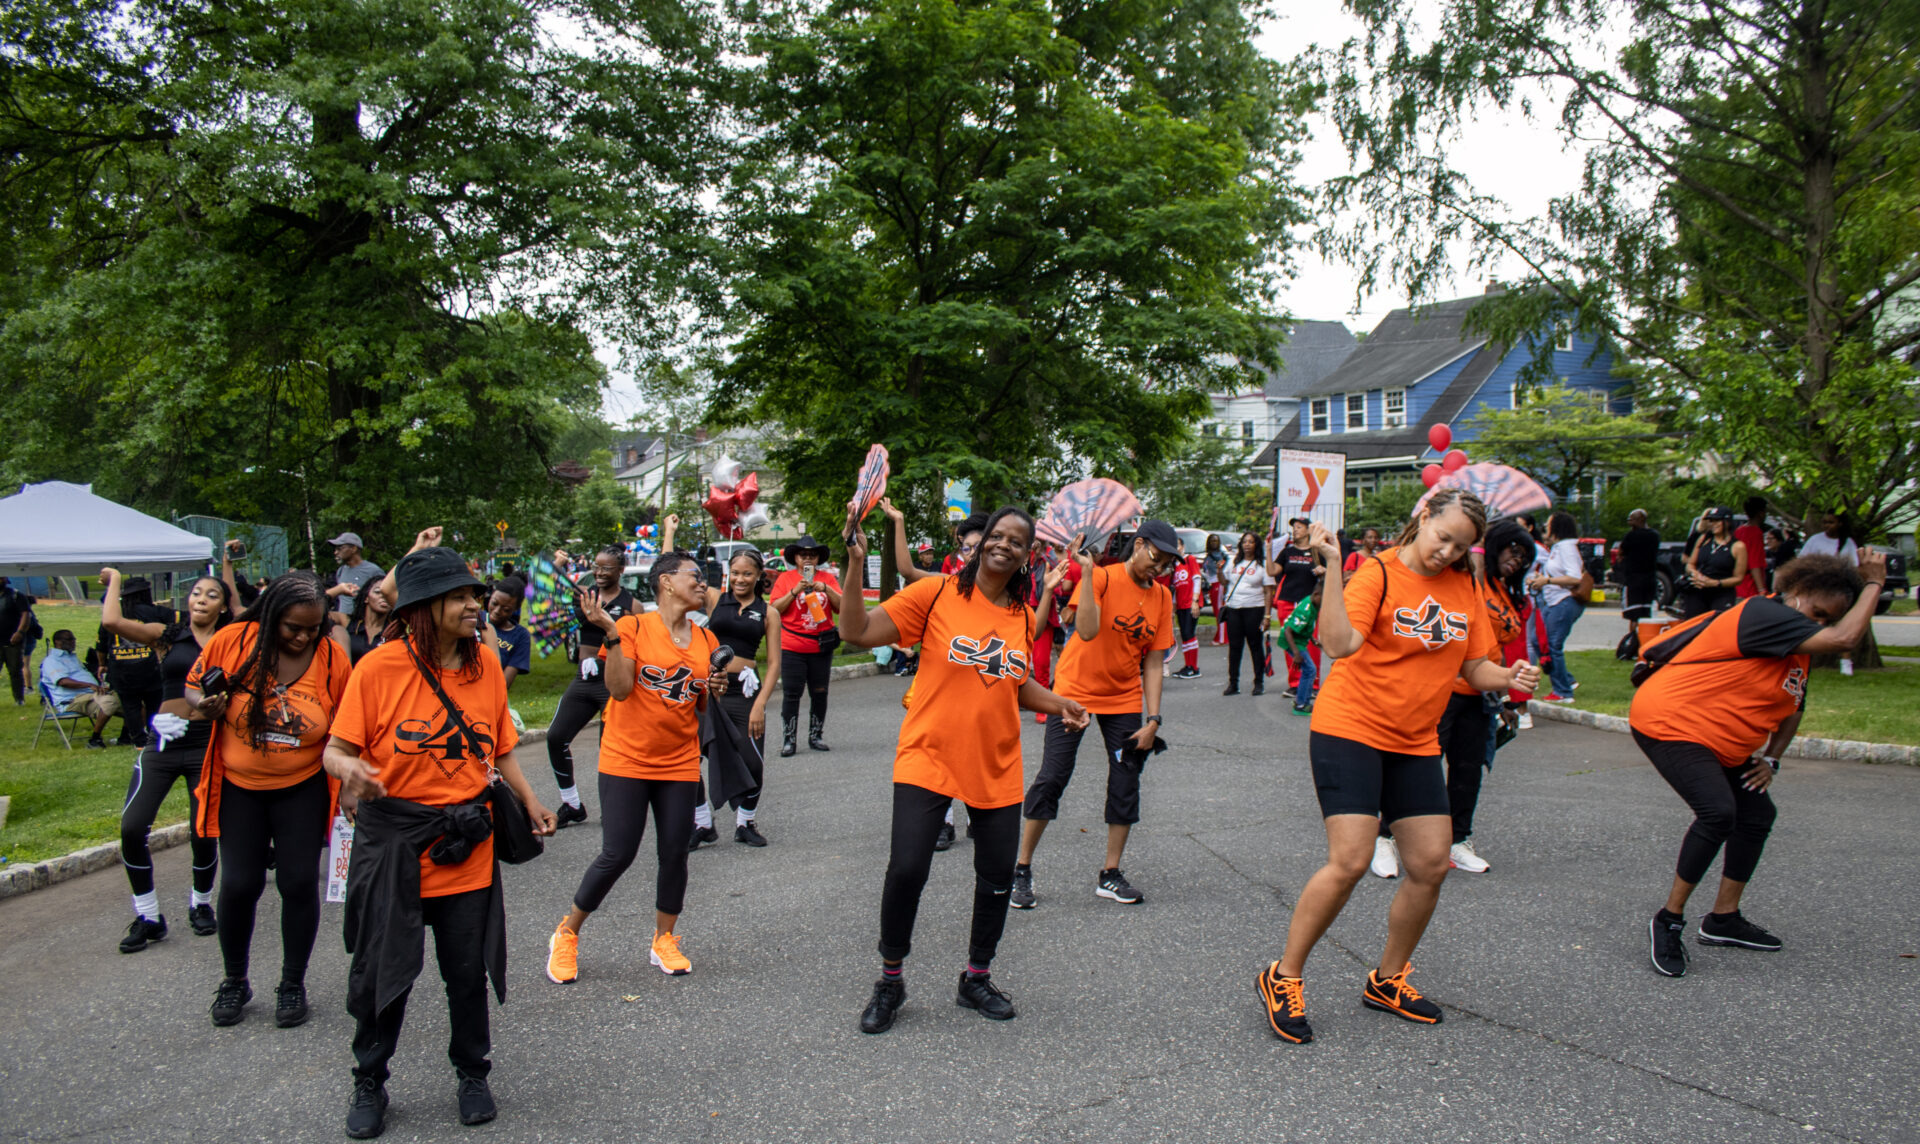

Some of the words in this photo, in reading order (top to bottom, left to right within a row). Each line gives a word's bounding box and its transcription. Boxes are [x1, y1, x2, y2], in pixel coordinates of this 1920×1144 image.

[1288, 488, 1303, 497] the
[1111, 615, 1157, 641] S4S
[1393, 603, 1468, 643] S4S
[948, 635, 1026, 680] S4S
[638, 665, 707, 704] S4S
